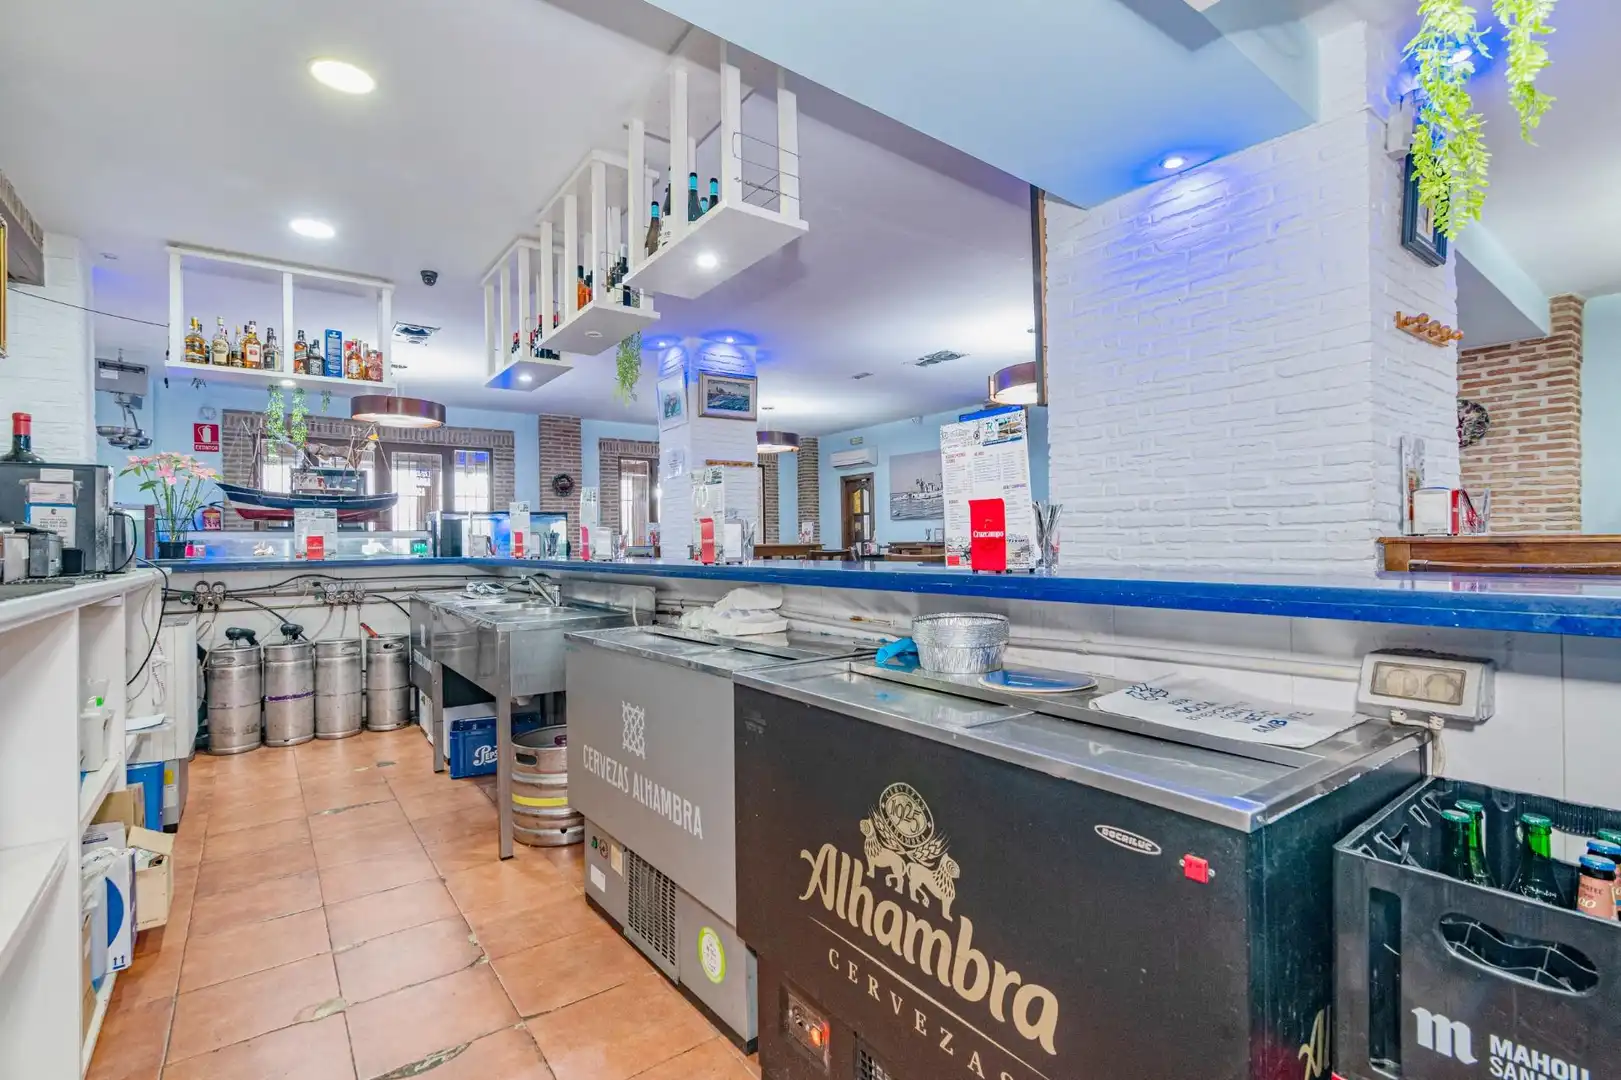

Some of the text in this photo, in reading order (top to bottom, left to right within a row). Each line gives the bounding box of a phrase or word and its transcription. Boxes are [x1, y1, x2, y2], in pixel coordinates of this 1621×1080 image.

[583, 744, 704, 840] CERVEZAS ALHAMBRA
[799, 843, 1059, 1056] Alhambra
